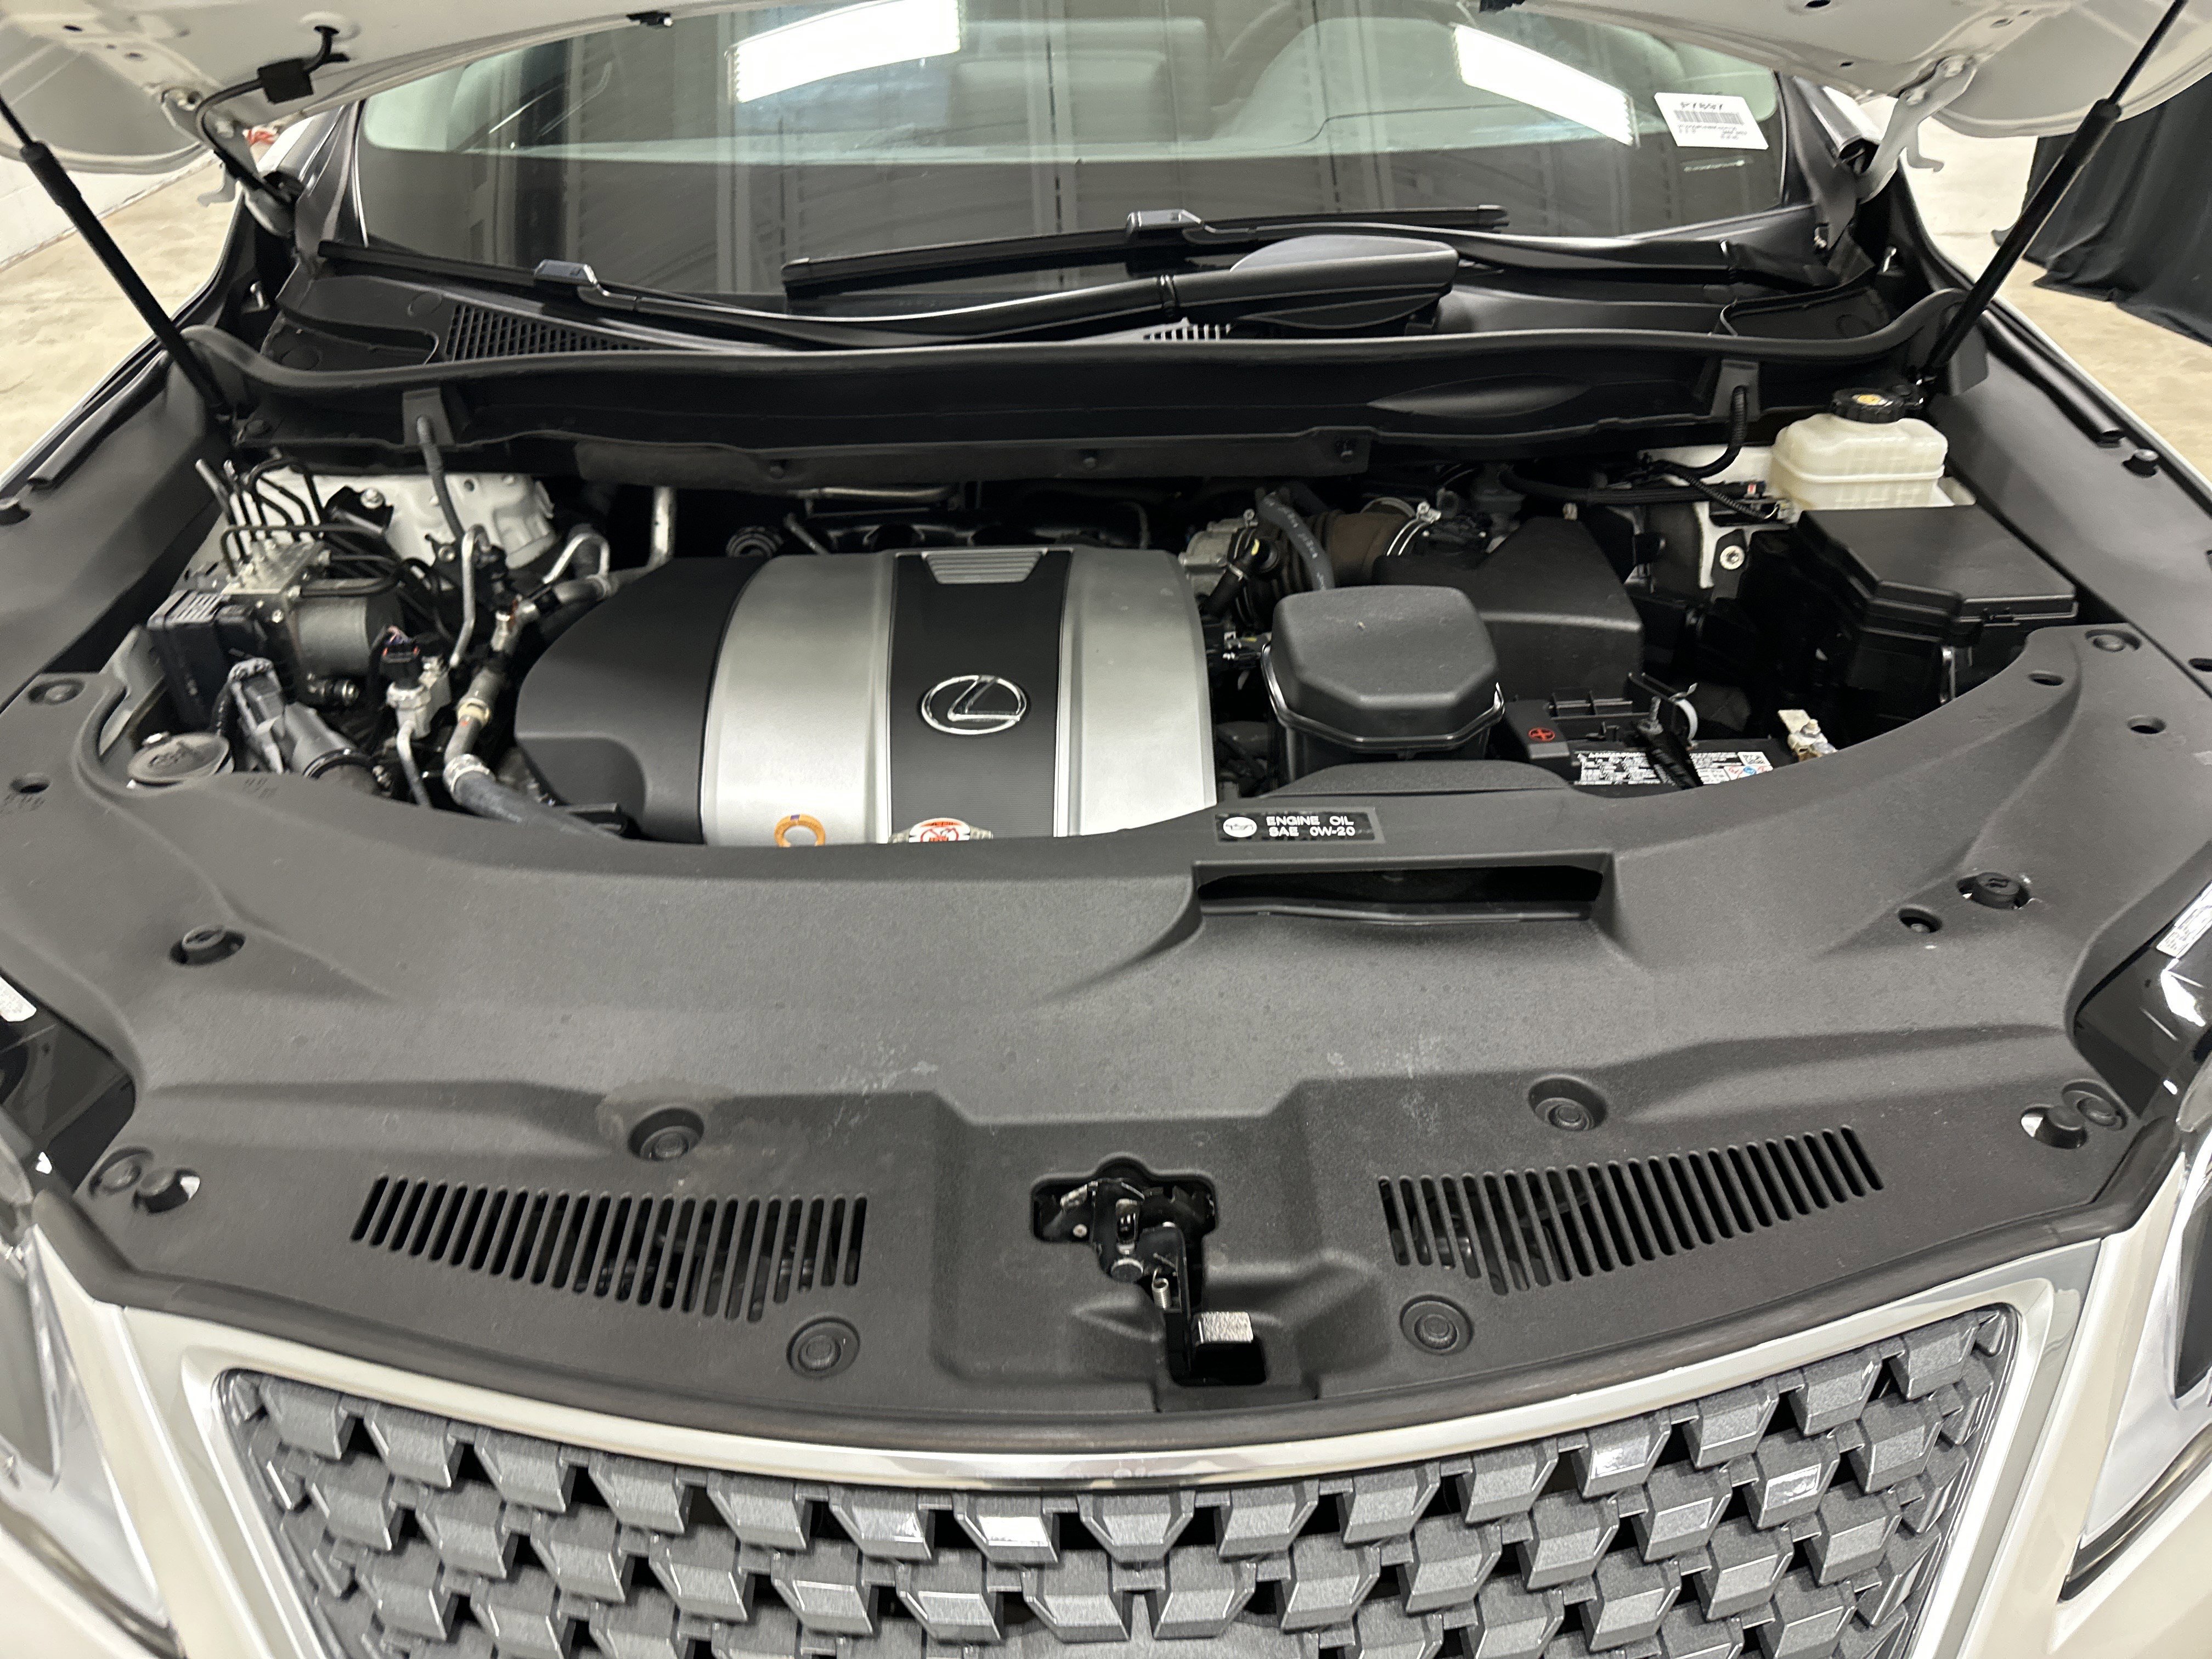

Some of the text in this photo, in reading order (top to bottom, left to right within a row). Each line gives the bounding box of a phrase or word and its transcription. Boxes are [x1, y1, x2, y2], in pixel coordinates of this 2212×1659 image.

[1266, 816, 1354, 826] ENGINE OIL
[1269, 826, 1355, 837] SAE 0W-20
